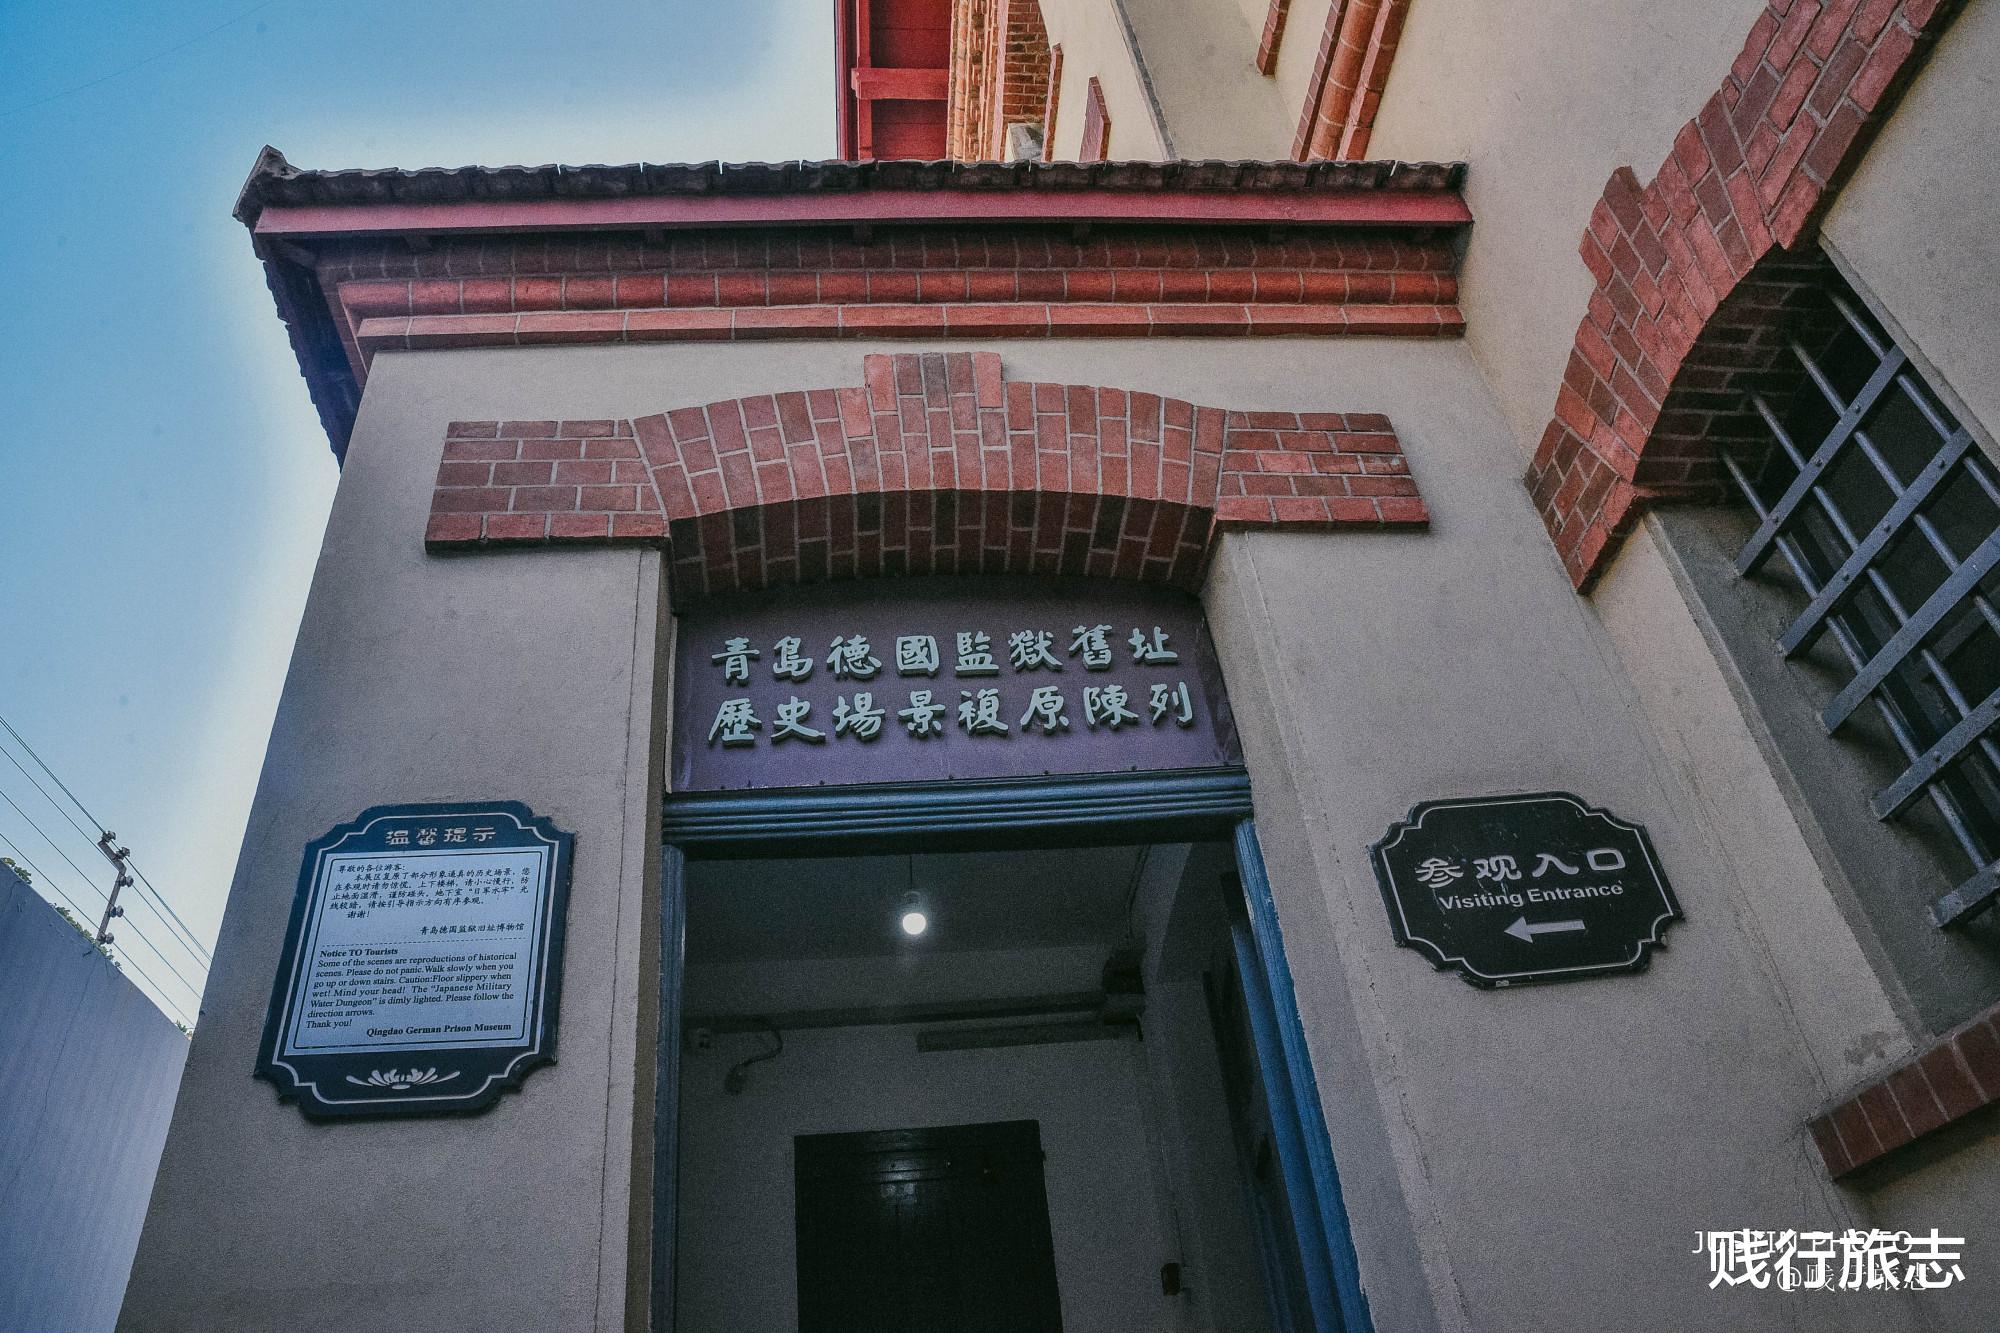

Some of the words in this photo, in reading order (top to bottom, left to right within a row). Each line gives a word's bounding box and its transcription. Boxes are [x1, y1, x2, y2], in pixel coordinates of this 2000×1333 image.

[711, 624, 1179, 685] 青島德國監獄舊址
[708, 680, 1195, 748] 歷史場景複原陳列
[385, 827, 496, 846] 温馨提示
[1415, 848, 1626, 889] 参观入口
[1439, 889, 1524, 911] Visiting
[1529, 882, 1624, 903] Entrance
[420, 922, 525, 936] 青岛德国监狱旧址博物馆
[410, 955, 465, 964] reproductions
[479, 952, 517, 961] historical
[447, 964, 473, 972] slowly
[349, 978, 370, 986] down
[456, 974, 488, 982] slippery
[360, 989, 378, 997] your
[382, 986, 405, 994] head!
[477, 983, 512, 991] Military
[388, 996, 411, 1005] dimly
[414, 995, 442, 1004] lighted.
[307, 1010, 343, 1018] direction
[306, 1020, 331, 1028] Thank
[334, 1019, 352, 1029] you!
[367, 1028, 403, 1037] Qingdao
[406, 1026, 441, 1034] German
